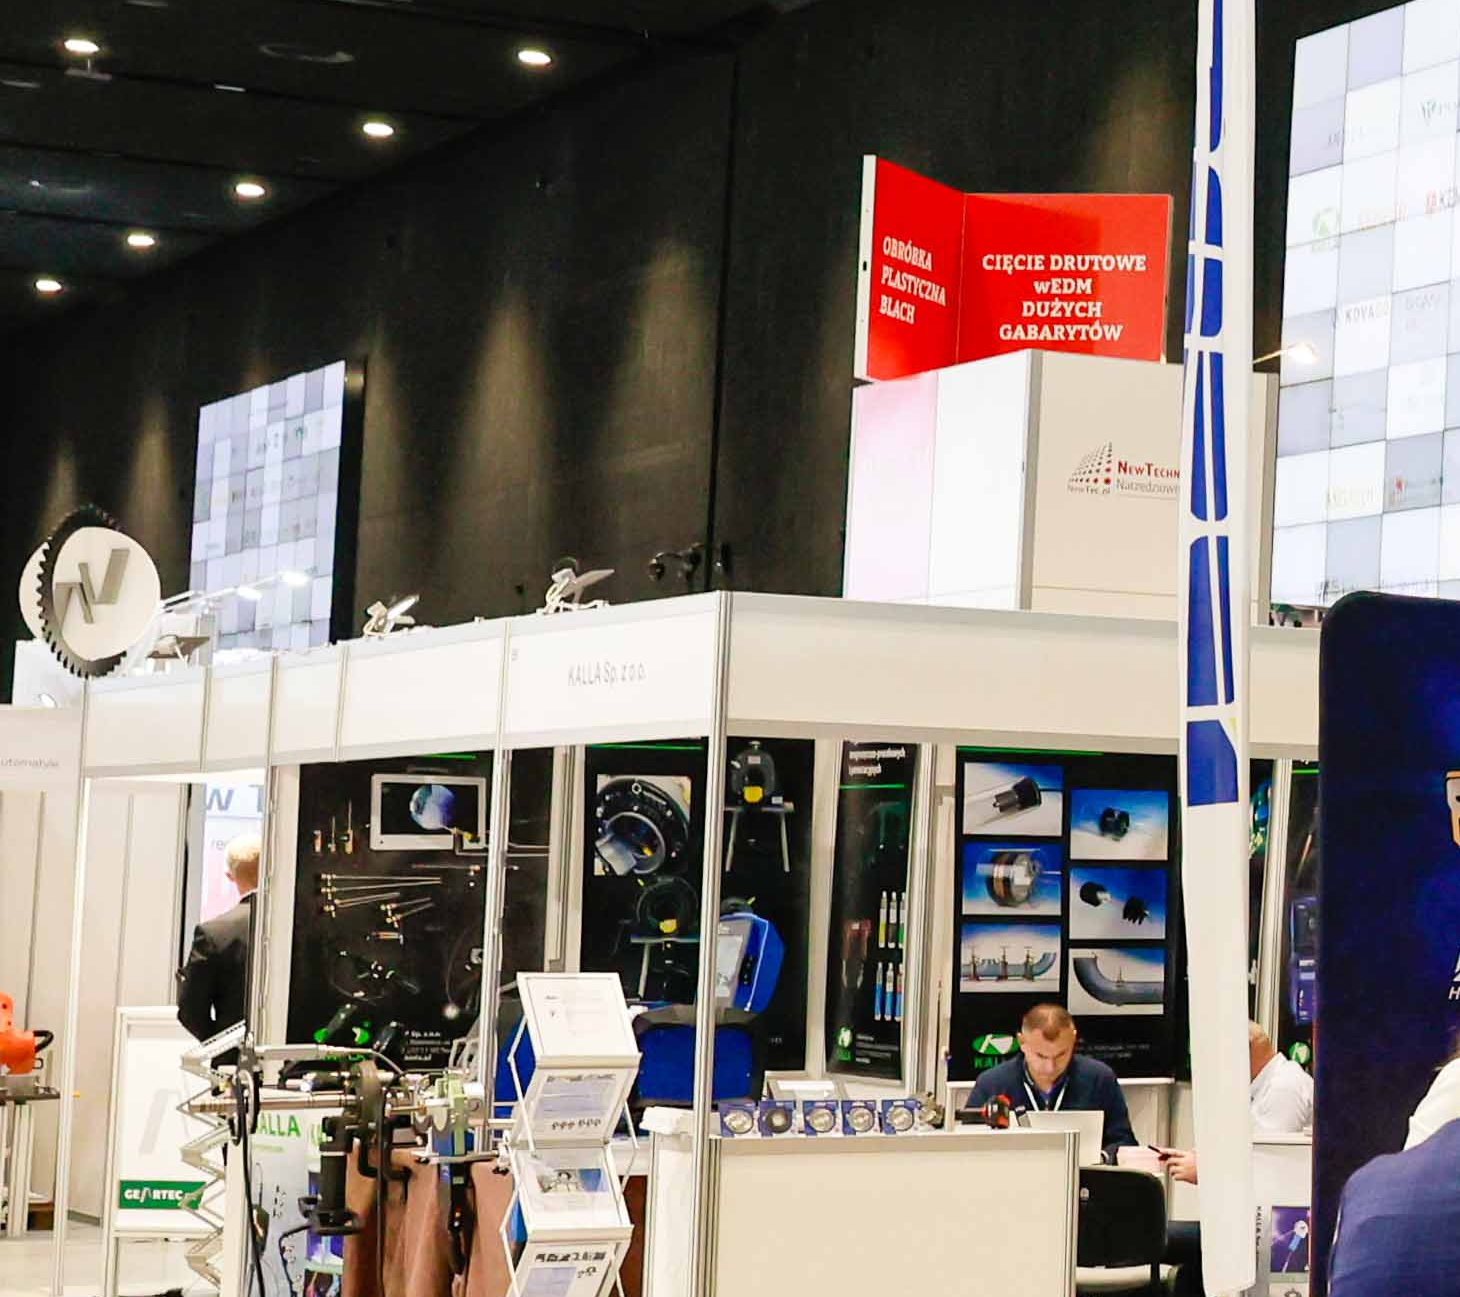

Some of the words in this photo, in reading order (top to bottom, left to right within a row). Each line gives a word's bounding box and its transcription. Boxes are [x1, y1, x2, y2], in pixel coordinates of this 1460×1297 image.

[883, 236, 932, 272] OBRÓBKA
[982, 254, 1046, 275] CIĘCIE
[1050, 254, 1146, 272] DRUTOWE
[881, 266, 946, 307] PLASTYCZNA
[1033, 278, 1092, 295] wEDM
[880, 294, 915, 325] BLACH
[1022, 297, 1102, 318] DUŻYCH
[999, 320, 1123, 342] GABARYTÓW
